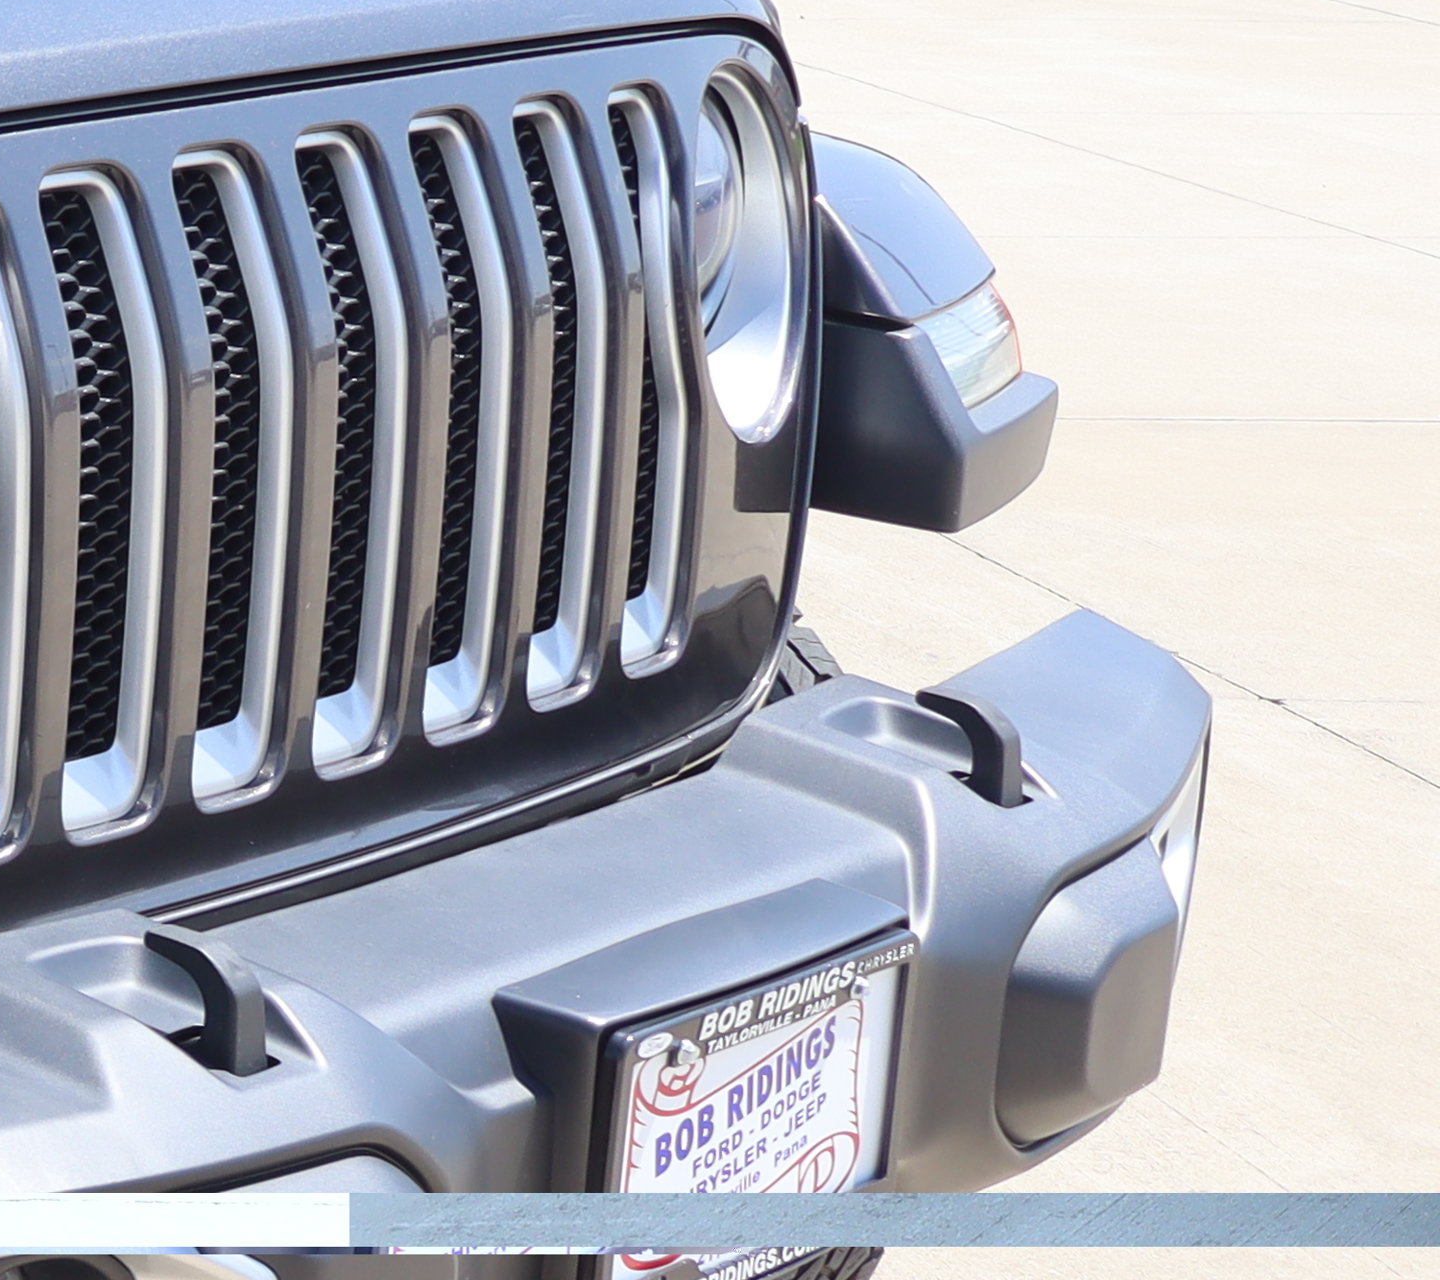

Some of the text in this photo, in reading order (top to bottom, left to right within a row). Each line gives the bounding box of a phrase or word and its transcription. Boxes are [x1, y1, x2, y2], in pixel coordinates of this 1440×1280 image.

[698, 961, 856, 1041] BOB RIDINGS
[707, 1010, 794, 1055] TAYLORVILLE
[802, 994, 837, 1019] PANA
[654, 1014, 837, 1178] BOB RIDINGS
[692, 1130, 743, 1178] FORD
[761, 1070, 822, 1130] DODGE
[783, 1092, 827, 1137] JEEP
[773, 1134, 808, 1168] Pana
